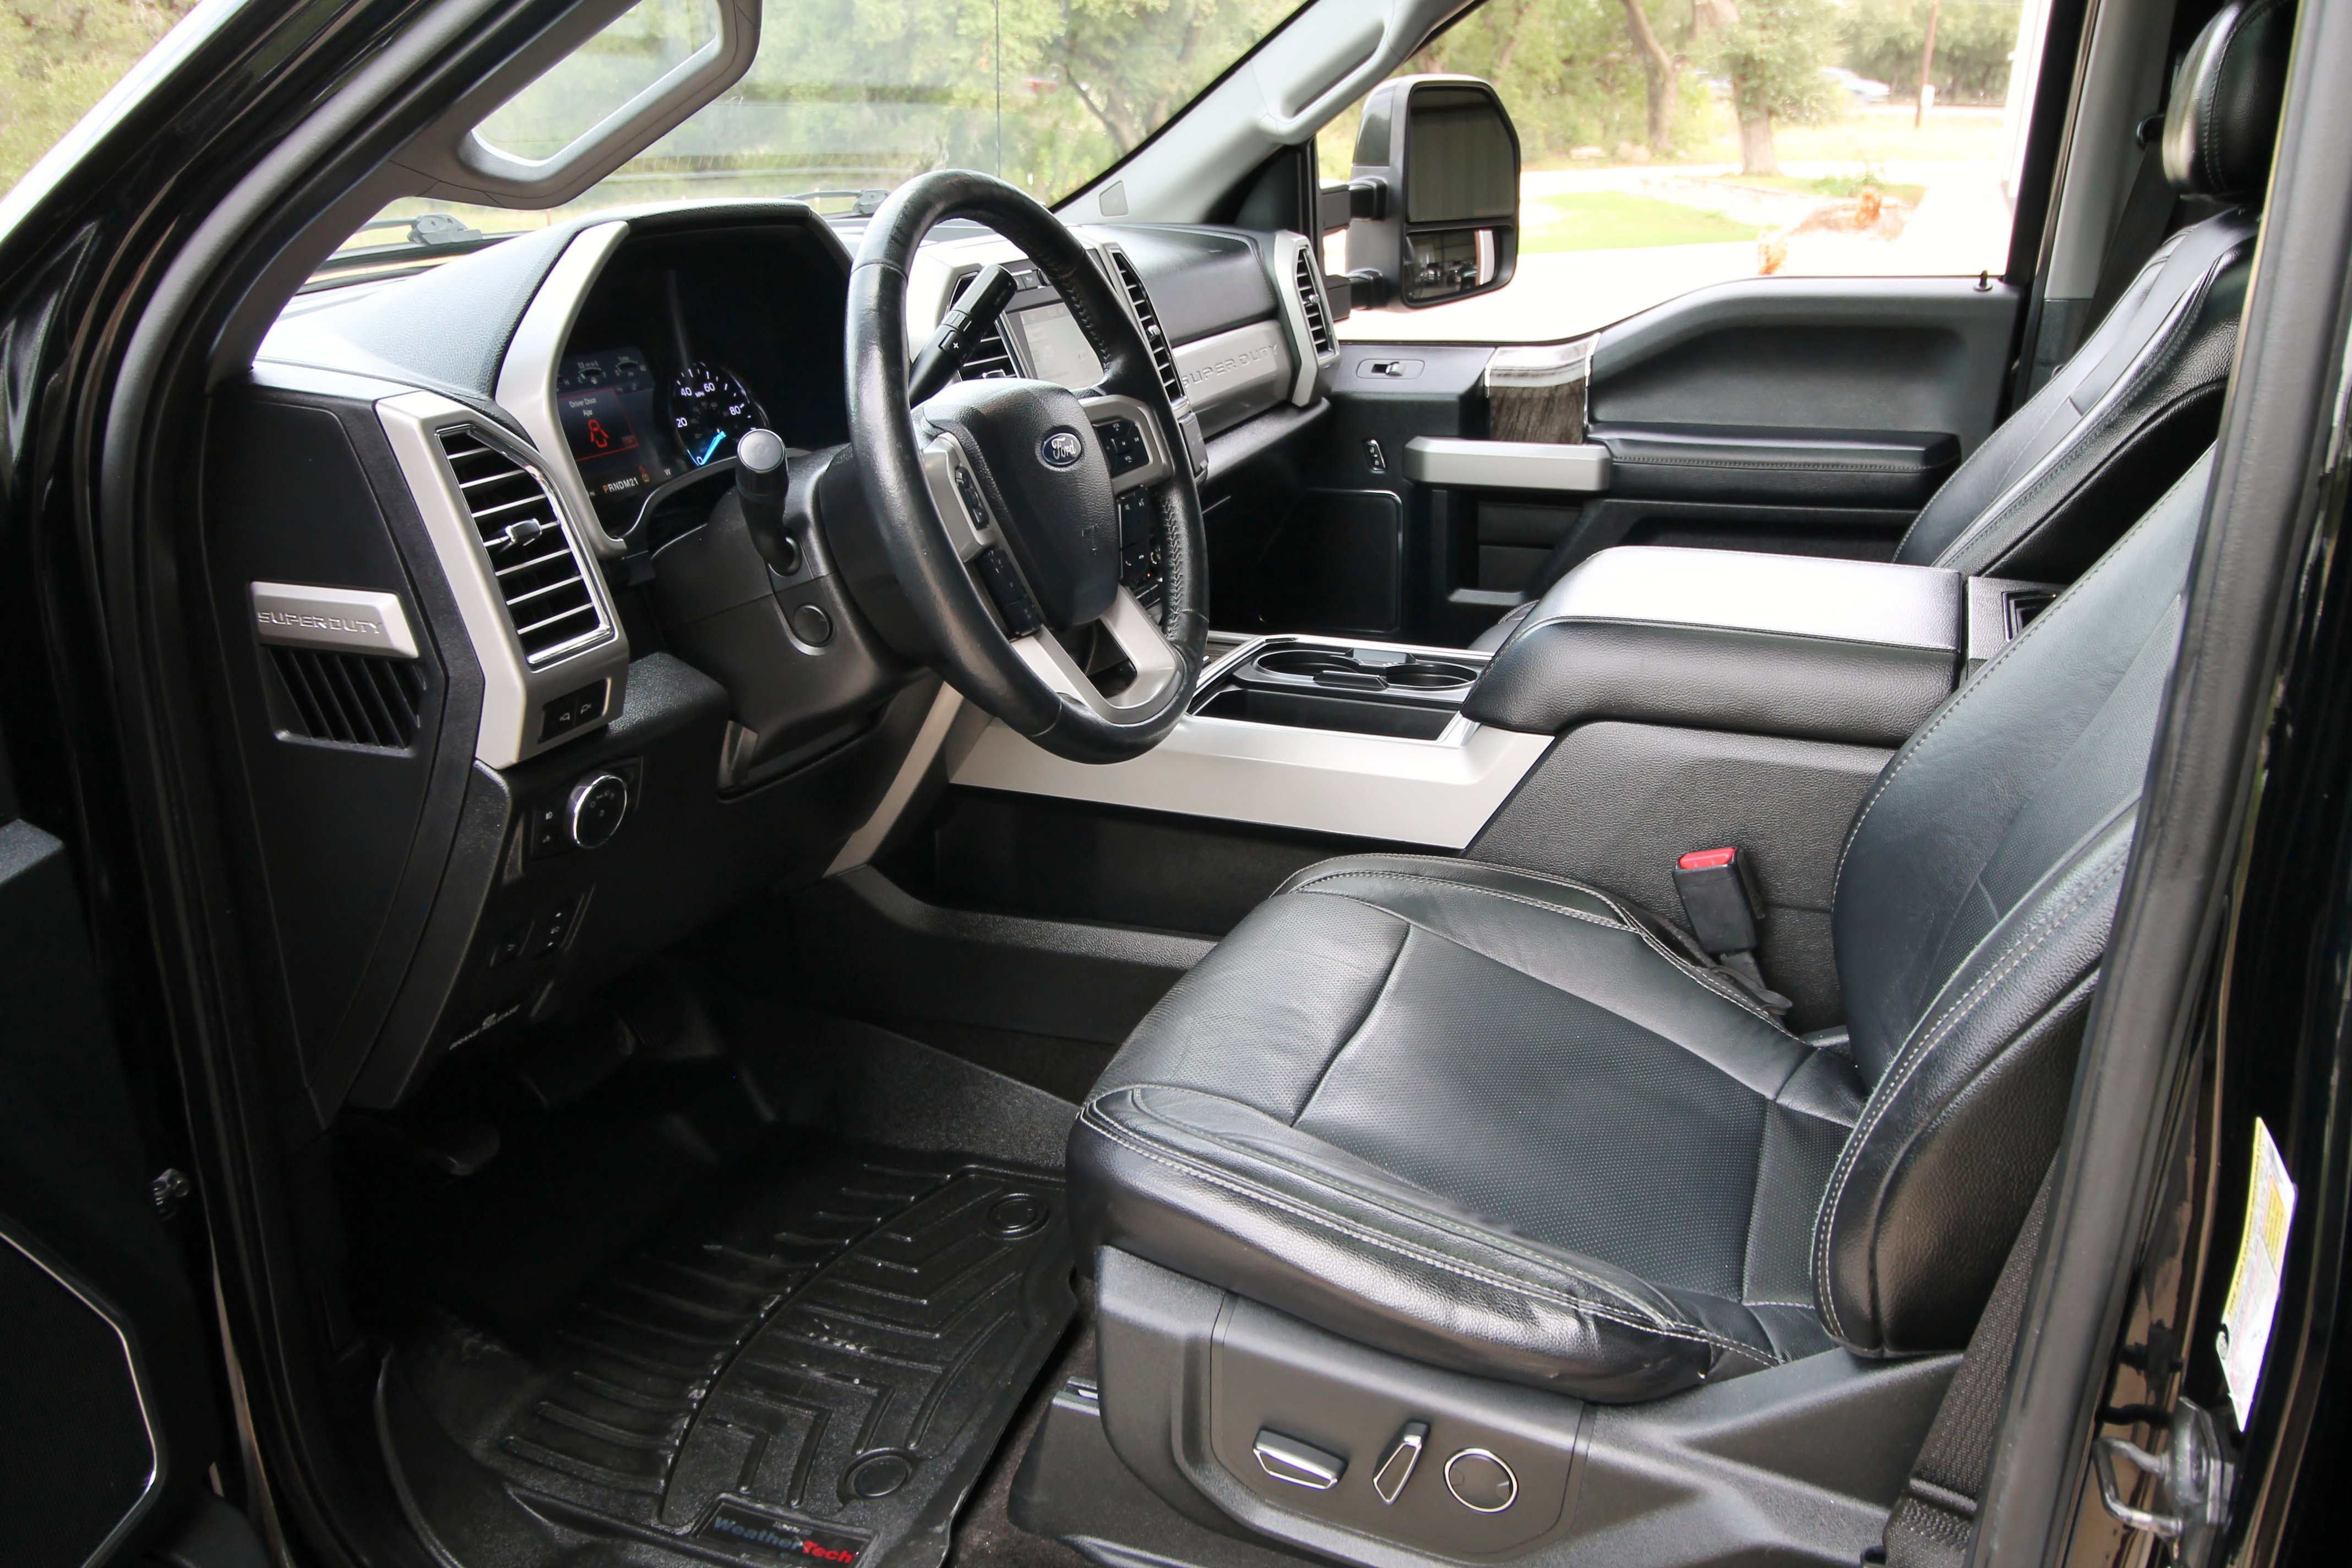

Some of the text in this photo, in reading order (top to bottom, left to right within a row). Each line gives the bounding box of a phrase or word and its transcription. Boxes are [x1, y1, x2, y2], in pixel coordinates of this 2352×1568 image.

[1182, 344, 1278, 387] SUPER DUTY
[680, 387, 692, 396] 40
[704, 382, 715, 393] 60
[729, 406, 741, 416] 80
[676, 417, 688, 428] 20
[1051, 438, 1077, 460] Ford
[696, 456, 703, 465] 0
[602, 477, 639, 493] PRNDM21
[258, 611, 382, 635] SUPER DUTY
[714, 1516, 854, 1564] WeatherTech
